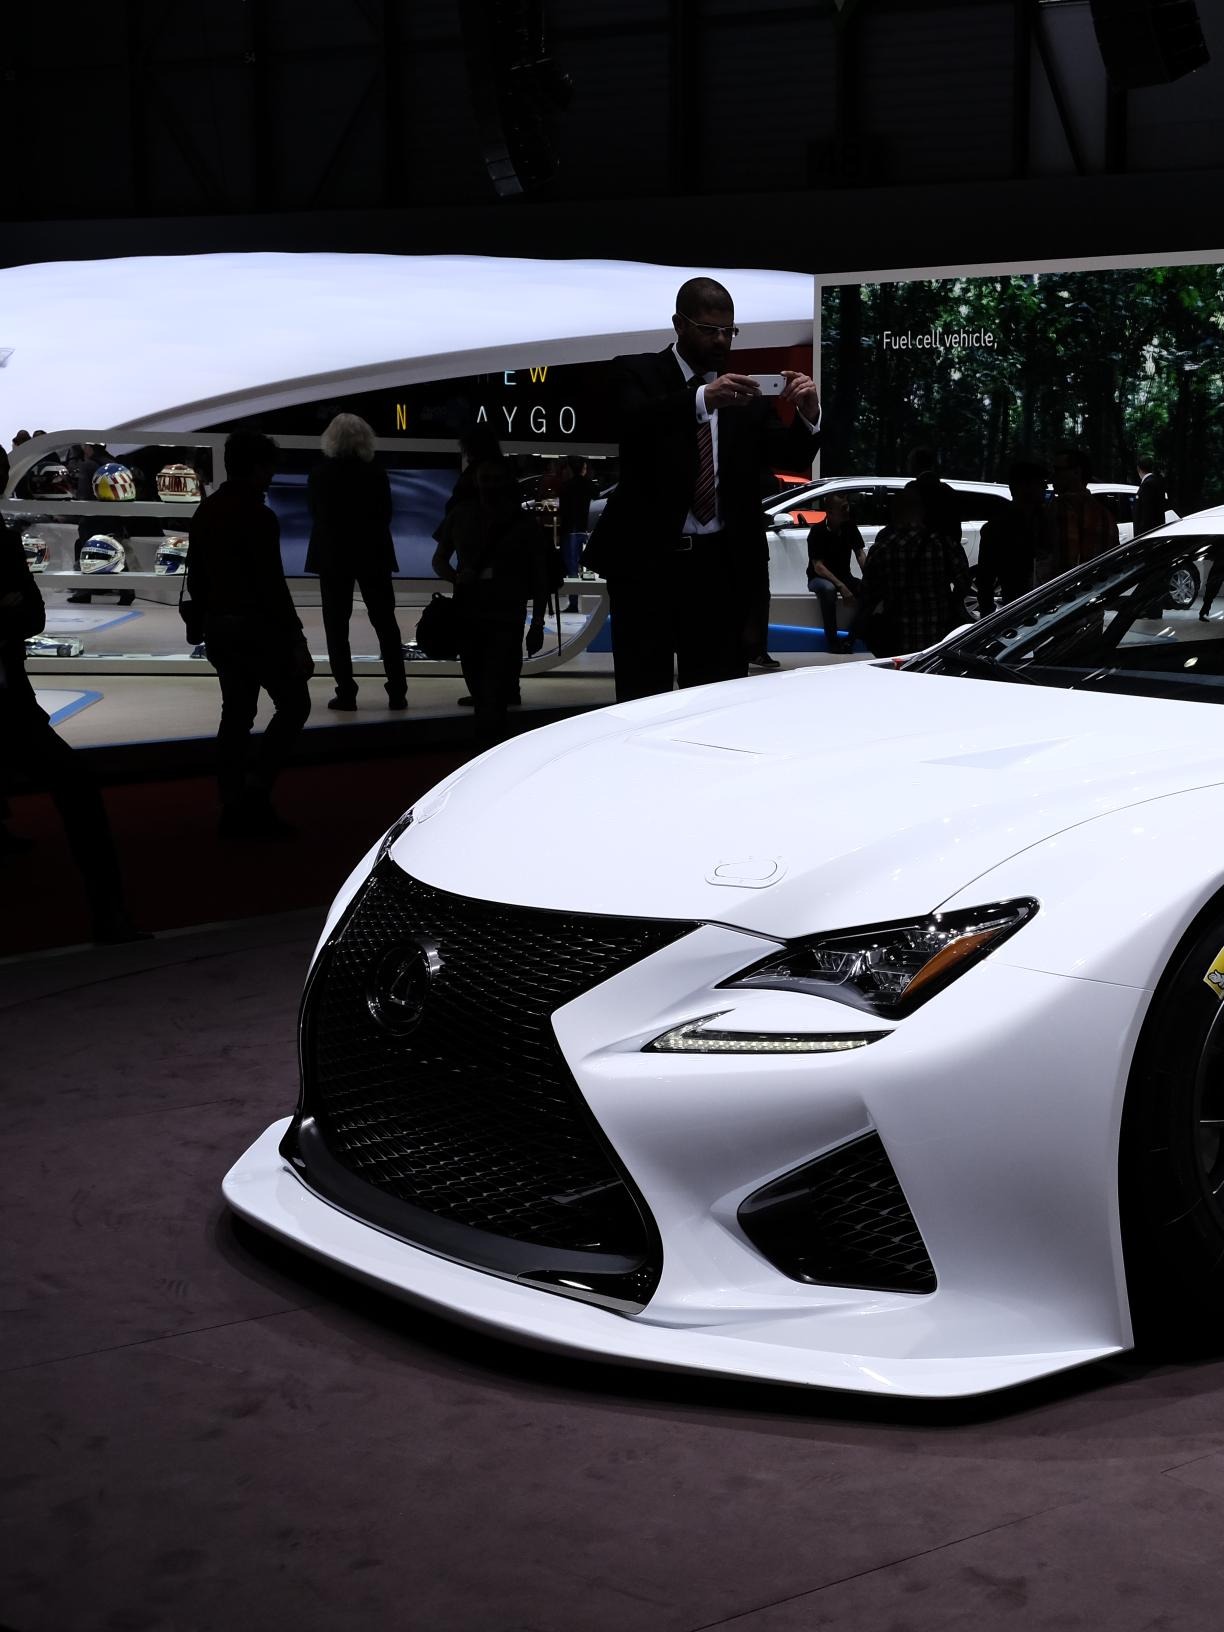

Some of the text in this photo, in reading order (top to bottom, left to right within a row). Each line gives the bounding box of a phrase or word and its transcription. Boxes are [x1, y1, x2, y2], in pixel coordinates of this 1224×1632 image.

[883, 327, 998, 350] Fuel cell vehicle,
[476, 405, 576, 434] AYGO
